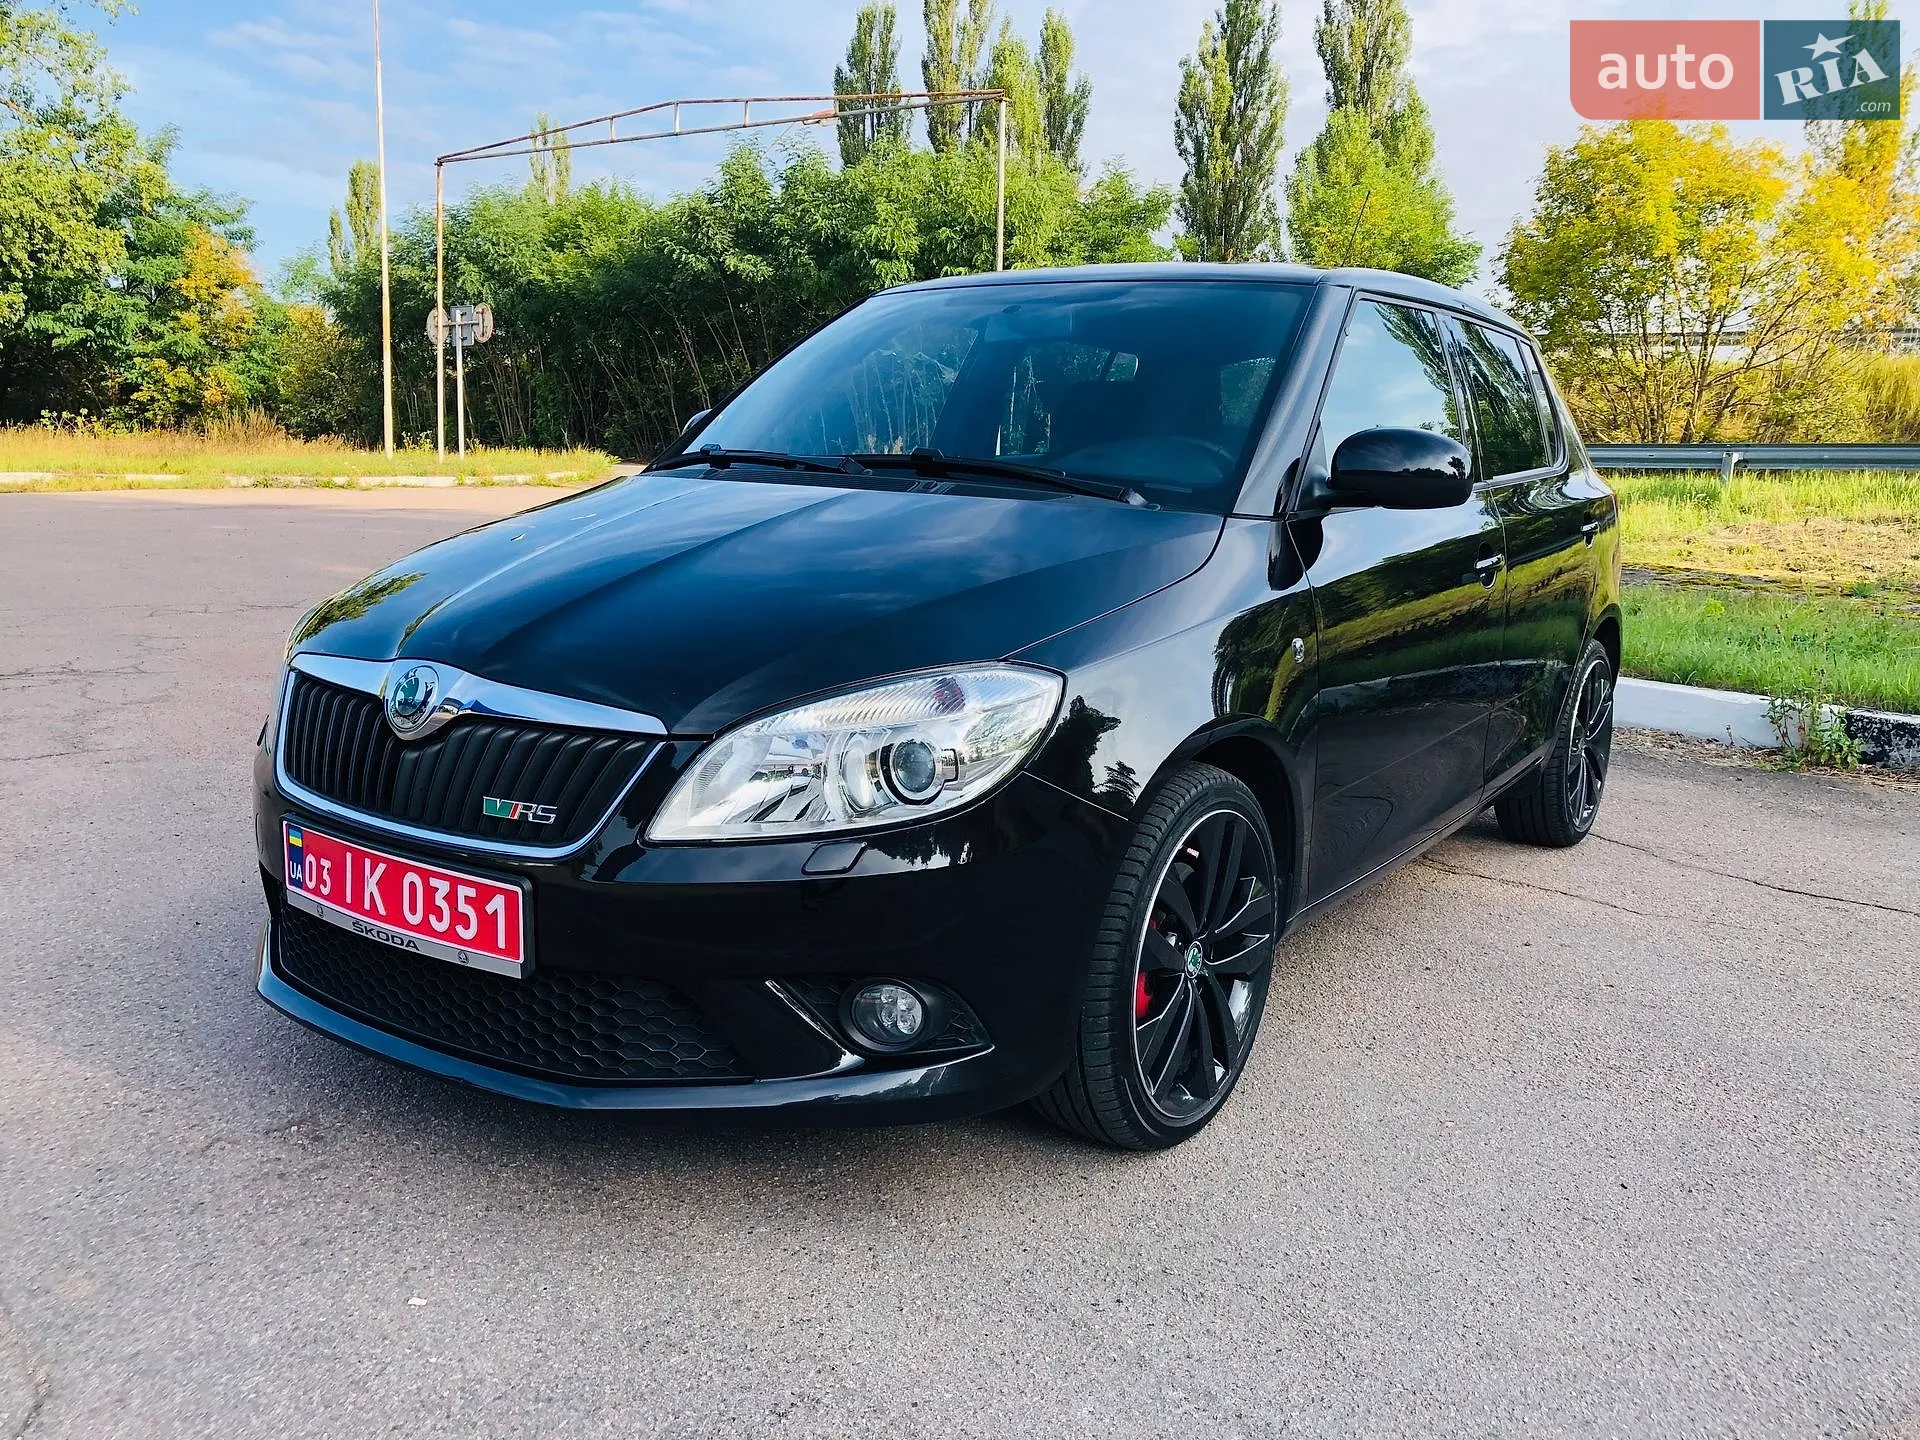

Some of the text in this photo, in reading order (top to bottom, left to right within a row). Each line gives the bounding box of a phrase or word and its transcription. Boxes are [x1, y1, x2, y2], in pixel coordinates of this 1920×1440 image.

[289, 860, 303, 883] UA
[305, 851, 507, 950] 03 IK 0351
[351, 920, 421, 952] ŠKODA
